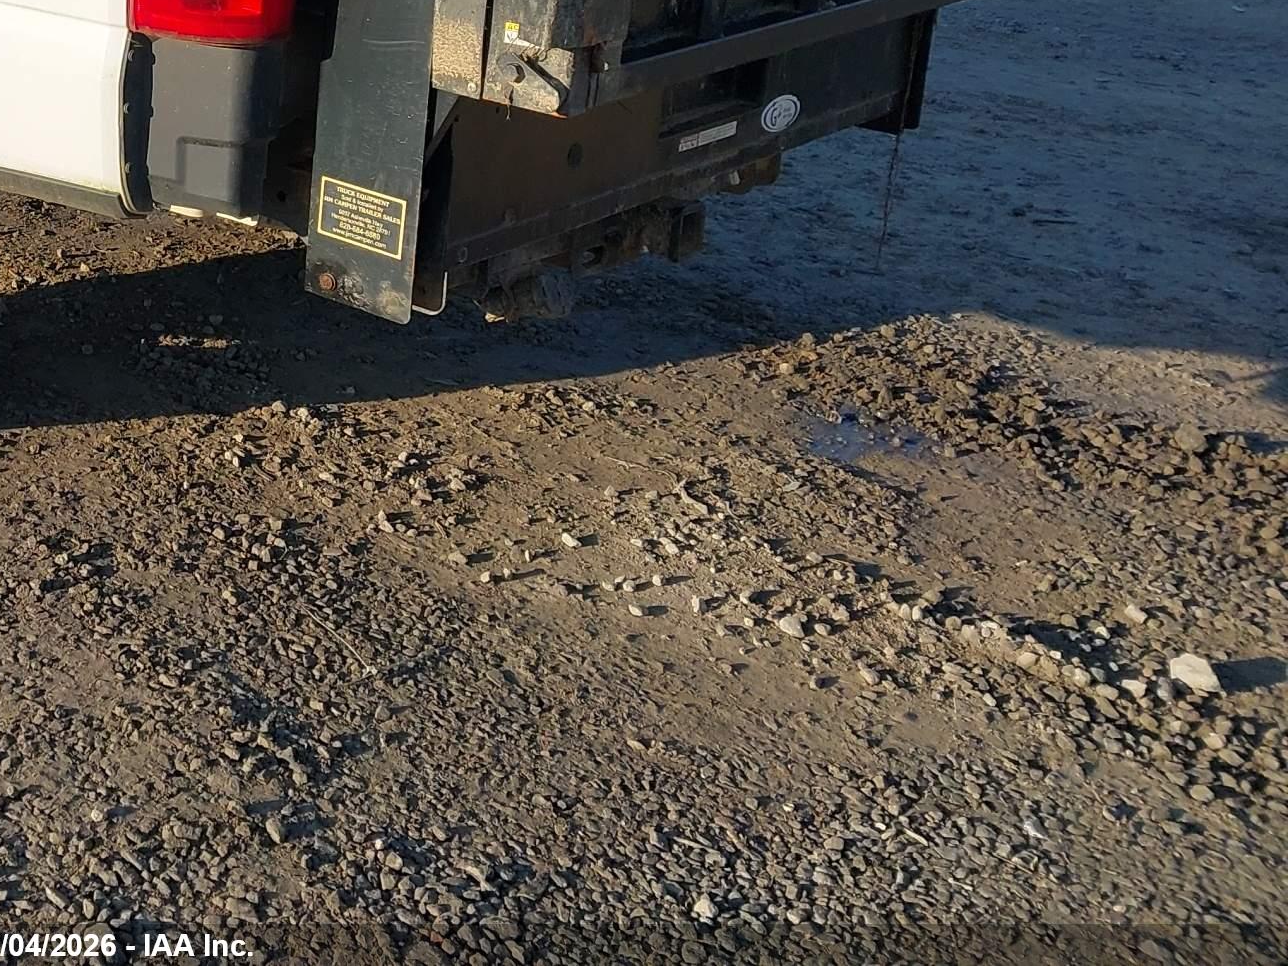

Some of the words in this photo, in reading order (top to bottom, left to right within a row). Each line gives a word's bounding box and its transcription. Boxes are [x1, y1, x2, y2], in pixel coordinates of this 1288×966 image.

[337, 187, 355, 197] TRUCK
[356, 192, 390, 207] EQUIPMENT
[382, 214, 401, 225] SALES
